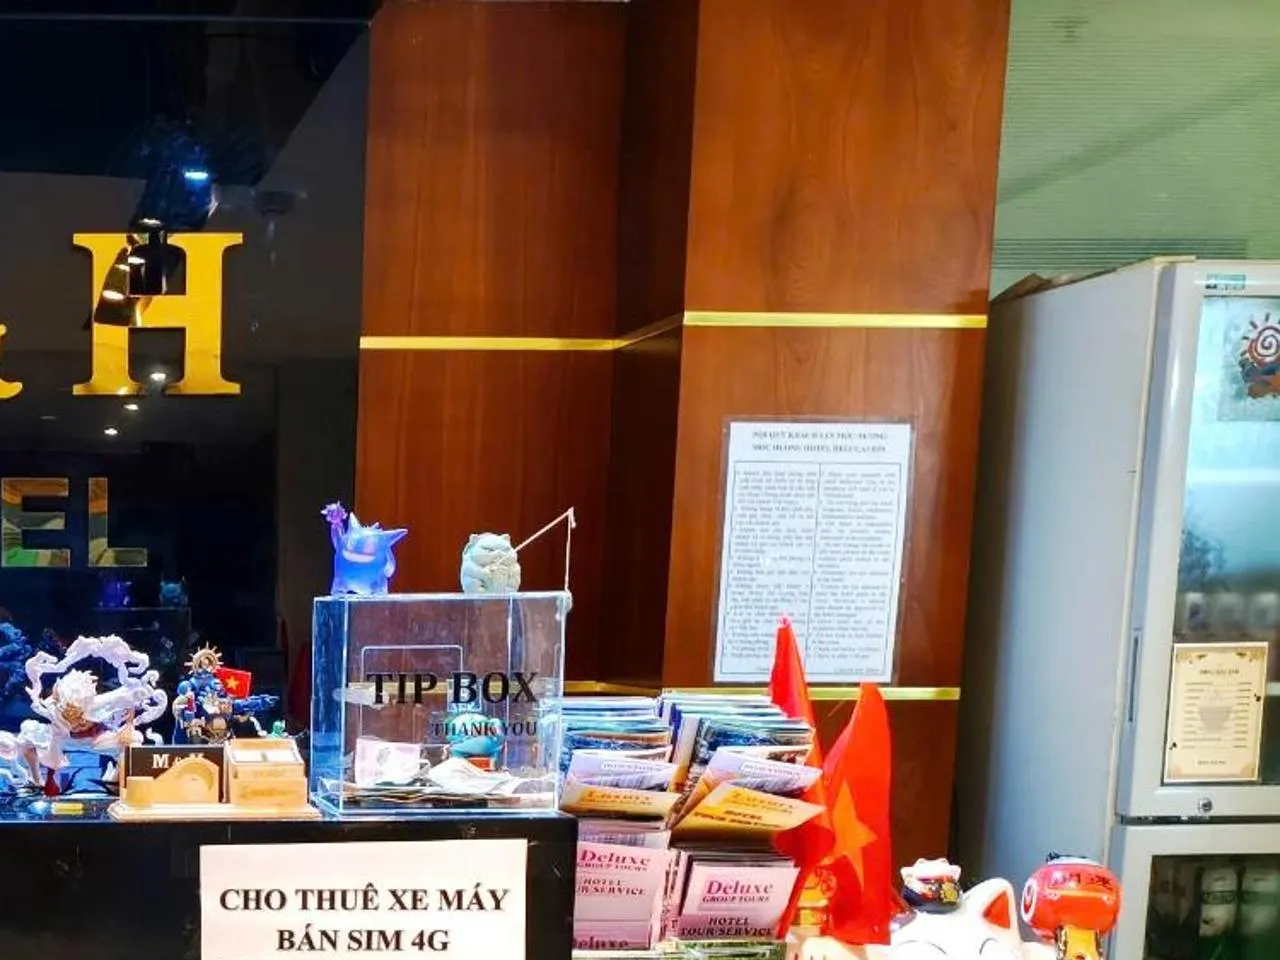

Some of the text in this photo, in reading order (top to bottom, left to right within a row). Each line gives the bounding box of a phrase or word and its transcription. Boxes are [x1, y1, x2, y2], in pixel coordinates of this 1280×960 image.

[72, 231, 243, 396] H
[366, 671, 539, 704] TIP BOX
[431, 721, 537, 736] THANK YOU
[580, 849, 651, 866] Deluxe
[707, 879, 774, 895] Deluxe
[219, 883, 510, 912] CHO THUÊ XE MÁY
[708, 916, 750, 926] HOTEL
[276, 923, 450, 951] BÁN SIM 4G
[680, 926, 715, 937] TOUR
